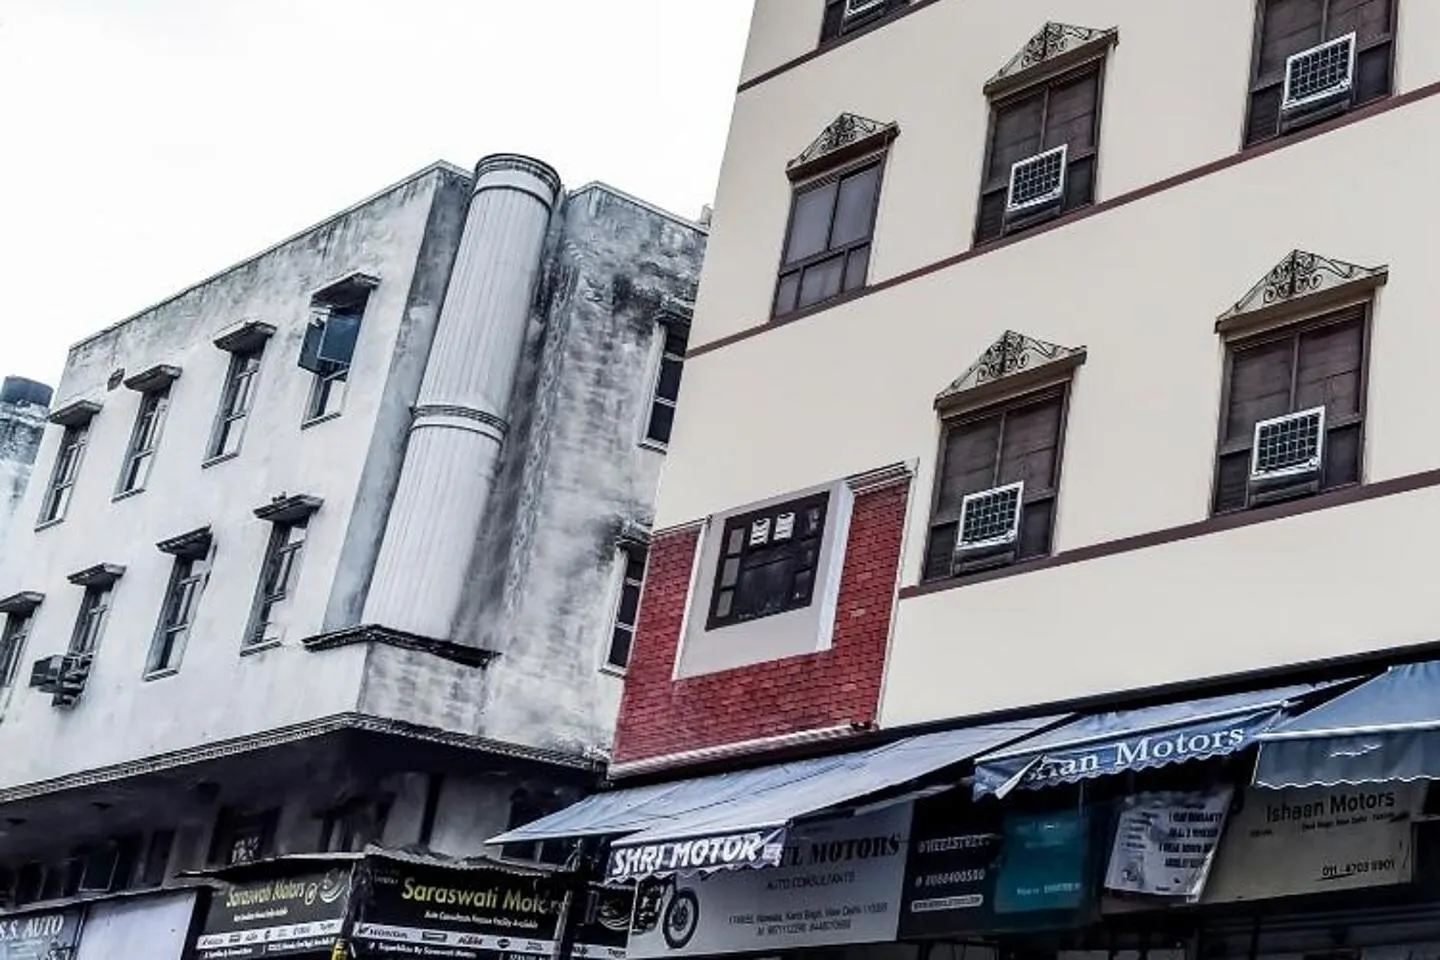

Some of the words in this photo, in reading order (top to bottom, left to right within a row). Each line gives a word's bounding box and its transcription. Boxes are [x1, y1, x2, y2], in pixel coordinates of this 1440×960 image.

[1115, 727, 1245, 766] Motors
[1266, 801, 1324, 823] Ishaan
[1330, 792, 1396, 814] Motors
[612, 844, 664, 875] SHRI
[809, 833, 900, 865] MOTORS
[401, 877, 499, 908] Saraswati
[23, 914, 64, 938] AUTO
